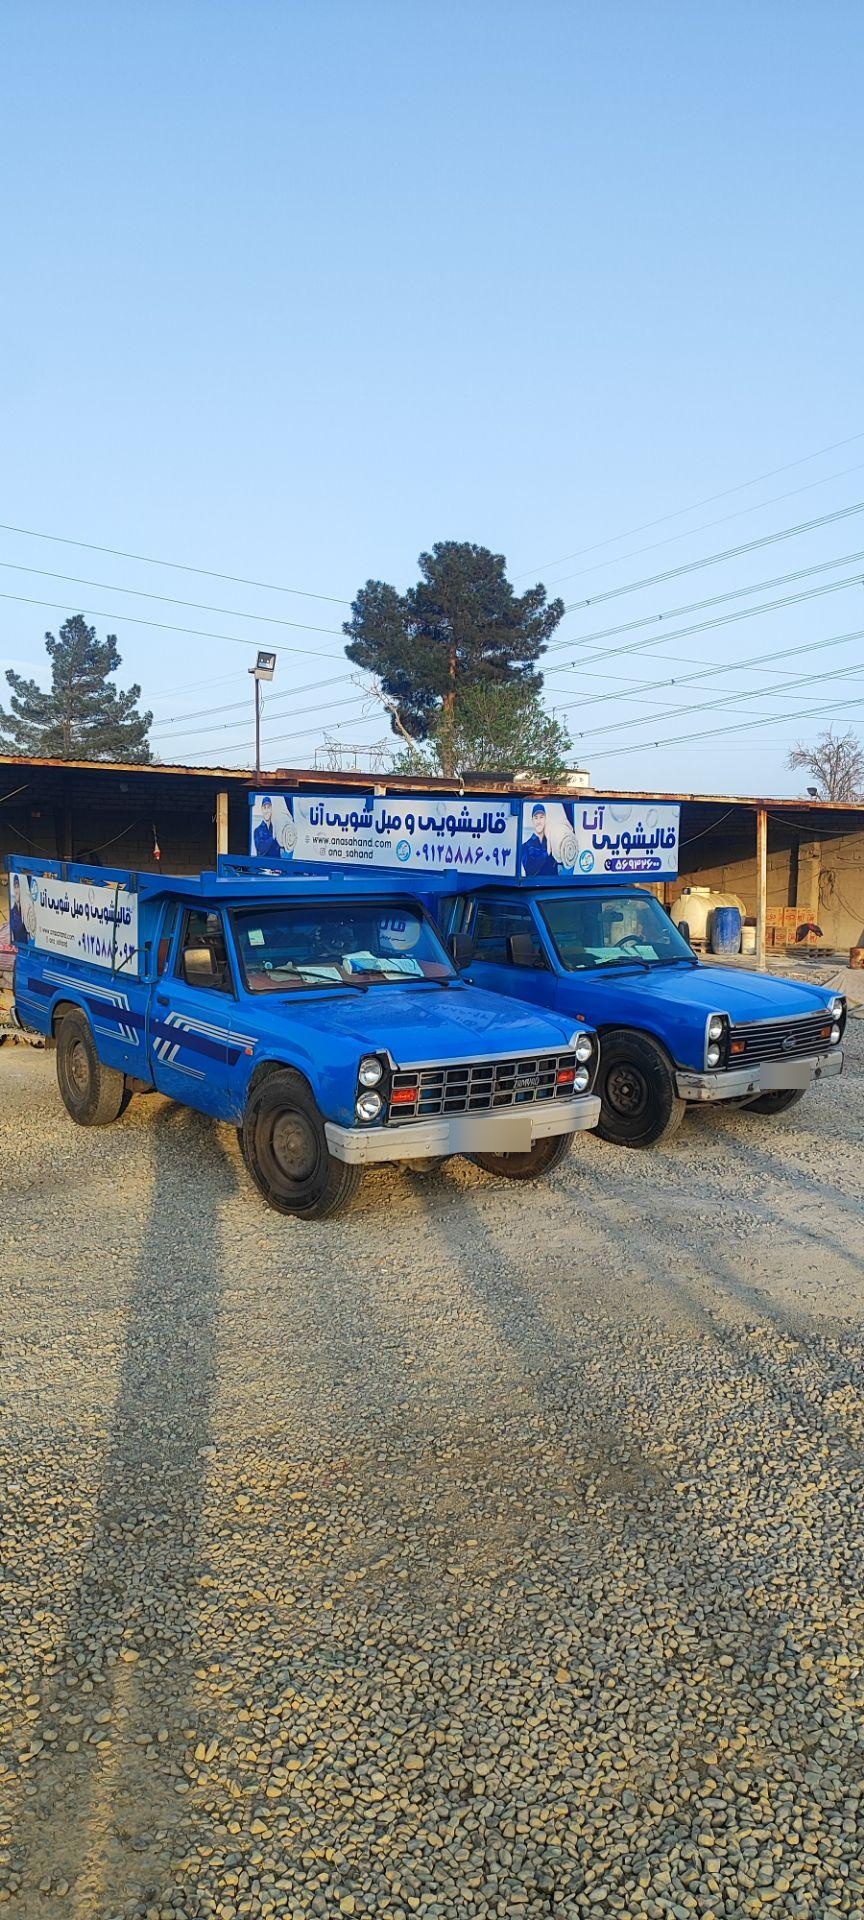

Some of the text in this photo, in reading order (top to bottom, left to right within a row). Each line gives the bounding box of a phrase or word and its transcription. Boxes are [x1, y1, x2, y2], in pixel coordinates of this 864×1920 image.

[309, 802, 506, 839] قالیشویی و مبل شویی آنا
[582, 806, 605, 830] آنا
[312, 836, 392, 848] www.anasahand.com
[592, 822, 676, 855] قالیشویی
[328, 848, 374, 859] ana_sahand
[415, 843, 512, 867] ۰۹۱۲۵۸۸۶۰۹۳
[71, 898, 84, 919] مبل
